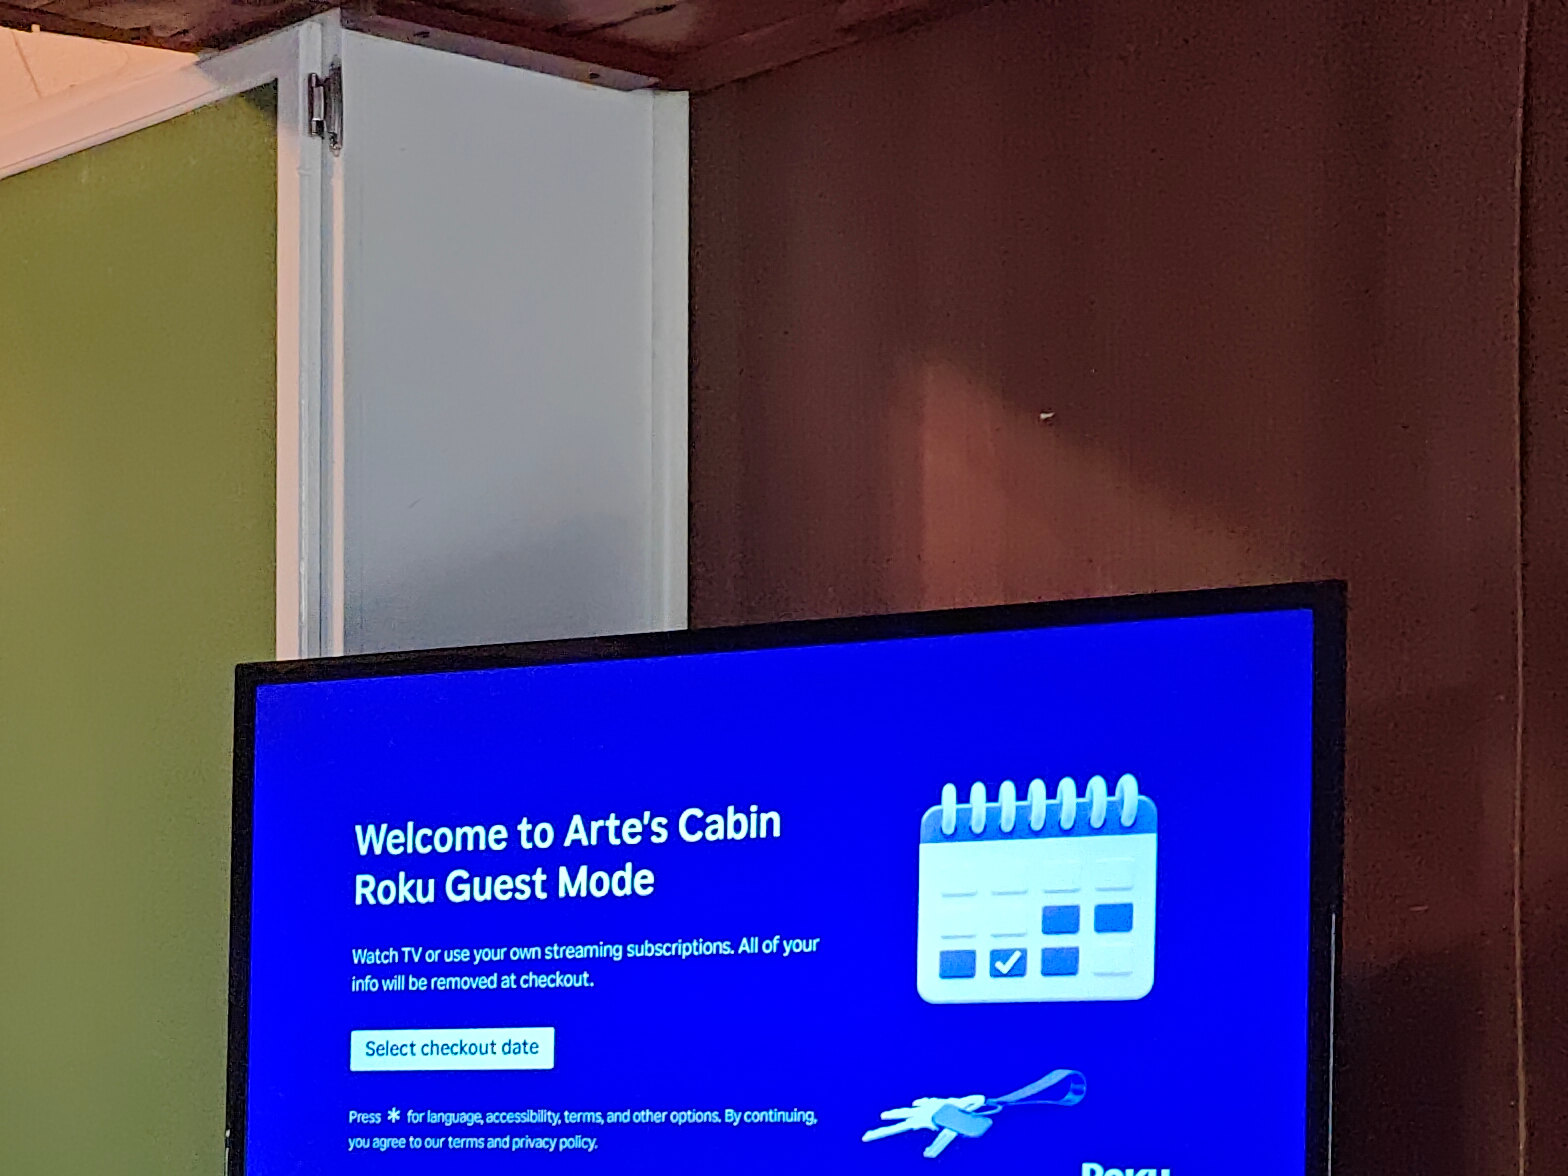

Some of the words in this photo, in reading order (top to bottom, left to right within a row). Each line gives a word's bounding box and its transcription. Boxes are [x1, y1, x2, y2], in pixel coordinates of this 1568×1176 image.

[354, 822, 508, 857] Welcome
[516, 816, 555, 850] to
[678, 804, 781, 843] Cabin
[354, 870, 436, 906] Roku
[444, 866, 548, 904] Guest
[558, 861, 655, 899] Mode
[351, 946, 399, 965] Watch
[400, 946, 423, 964] TV
[424, 948, 442, 964] or
[443, 948, 471, 964] use
[472, 947, 508, 966] your
[509, 946, 542, 961] own
[544, 941, 624, 962] streaming
[626, 937, 735, 960] subscriptions.
[737, 936, 759, 955] All
[761, 934, 781, 954] of
[782, 936, 821, 957] your
[351, 974, 380, 993] info
[381, 974, 406, 992] will
[408, 973, 428, 991] be
[430, 972, 498, 991] removed
[500, 972, 518, 989] at
[519, 970, 595, 989] checkout.
[365, 1040, 416, 1057] Select
[421, 1039, 497, 1056] checkout
[501, 1039, 539, 1056] date
[348, 1110, 382, 1125] Press
[406, 1109, 426, 1124] for
[426, 1109, 484, 1127] language,
[485, 1108, 562, 1127] accessibility,
[563, 1109, 605, 1126] terms,
[606, 1108, 631, 1124] and
[631, 1108, 668, 1124] other
[669, 1108, 722, 1126] options.
[724, 1108, 742, 1127] By
[743, 1107, 819, 1127] continuing,
[347, 1136, 371, 1152] you
[371, 1136, 407, 1152] agree
[408, 1135, 423, 1149] to
[423, 1136, 447, 1149] our
[447, 1135, 486, 1149] terms
[486, 1134, 511, 1149] and
[511, 1134, 558, 1153] privacy
[558, 1134, 599, 1153] policy.
